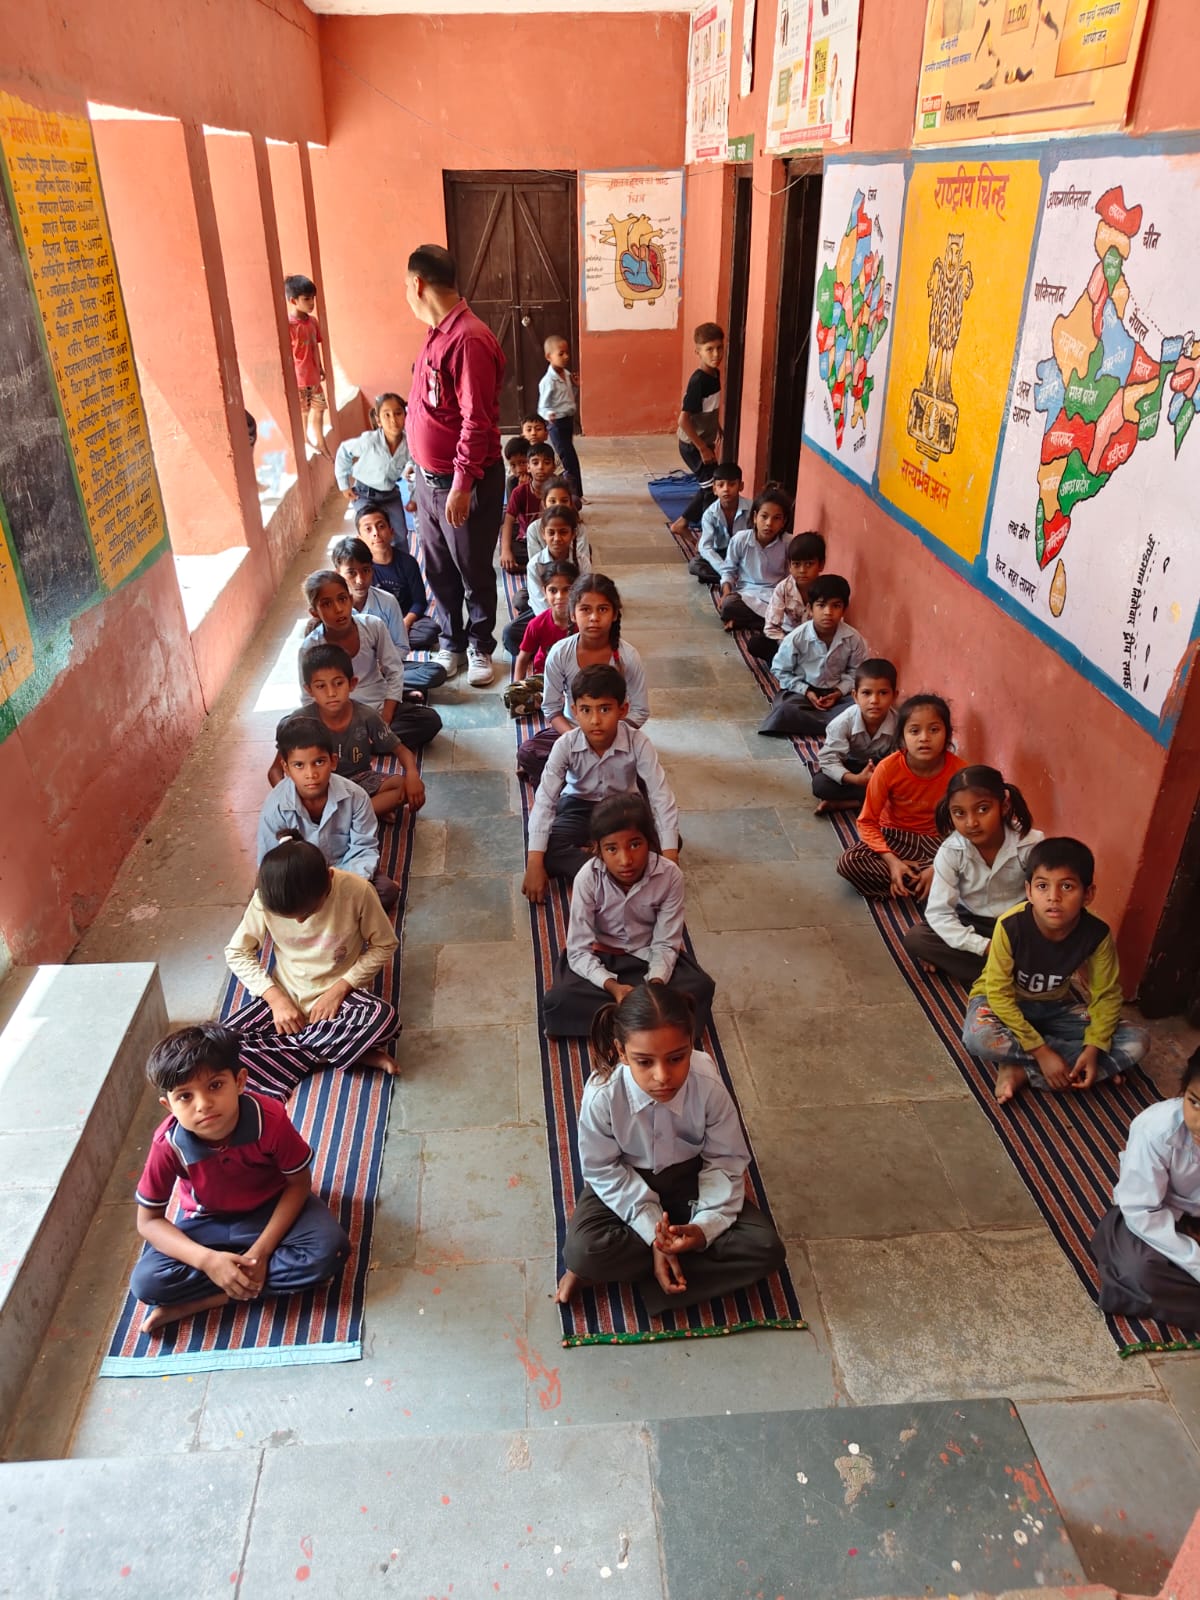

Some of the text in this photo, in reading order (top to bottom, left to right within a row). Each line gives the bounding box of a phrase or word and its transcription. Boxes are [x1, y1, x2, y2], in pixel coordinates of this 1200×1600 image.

[1007, 4, 1027, 25] 11:00
[1097, 2, 1121, 18] नमस्कार
[1083, 28, 1107, 46] आयोजन
[943, 101, 967, 122] विद्यालय
[967, 101, 980, 119] नाम
[934, 161, 1010, 222] राष्ट्रीय चिन्ह
[59, 216, 77, 233] दिवस
[64, 237, 79, 254] दिवस
[1143, 223, 1161, 249] चीन
[1034, 276, 1067, 305] पाकिस्तान
[84, 314, 99, 329] दिवस
[1128, 309, 1149, 341] नेपाल
[1133, 356, 1152, 380] बिहार
[1016, 380, 1032, 402] अरब
[1069, 383, 1099, 406] मध्य प्रदेश
[1013, 405, 1031, 427] सागर
[901, 457, 952, 510] सत्यमेव जयते
[1018, 522, 1030, 541] द्वीप
[1008, 568, 1020, 588] महा
[1019, 576, 1037, 603] सागर
